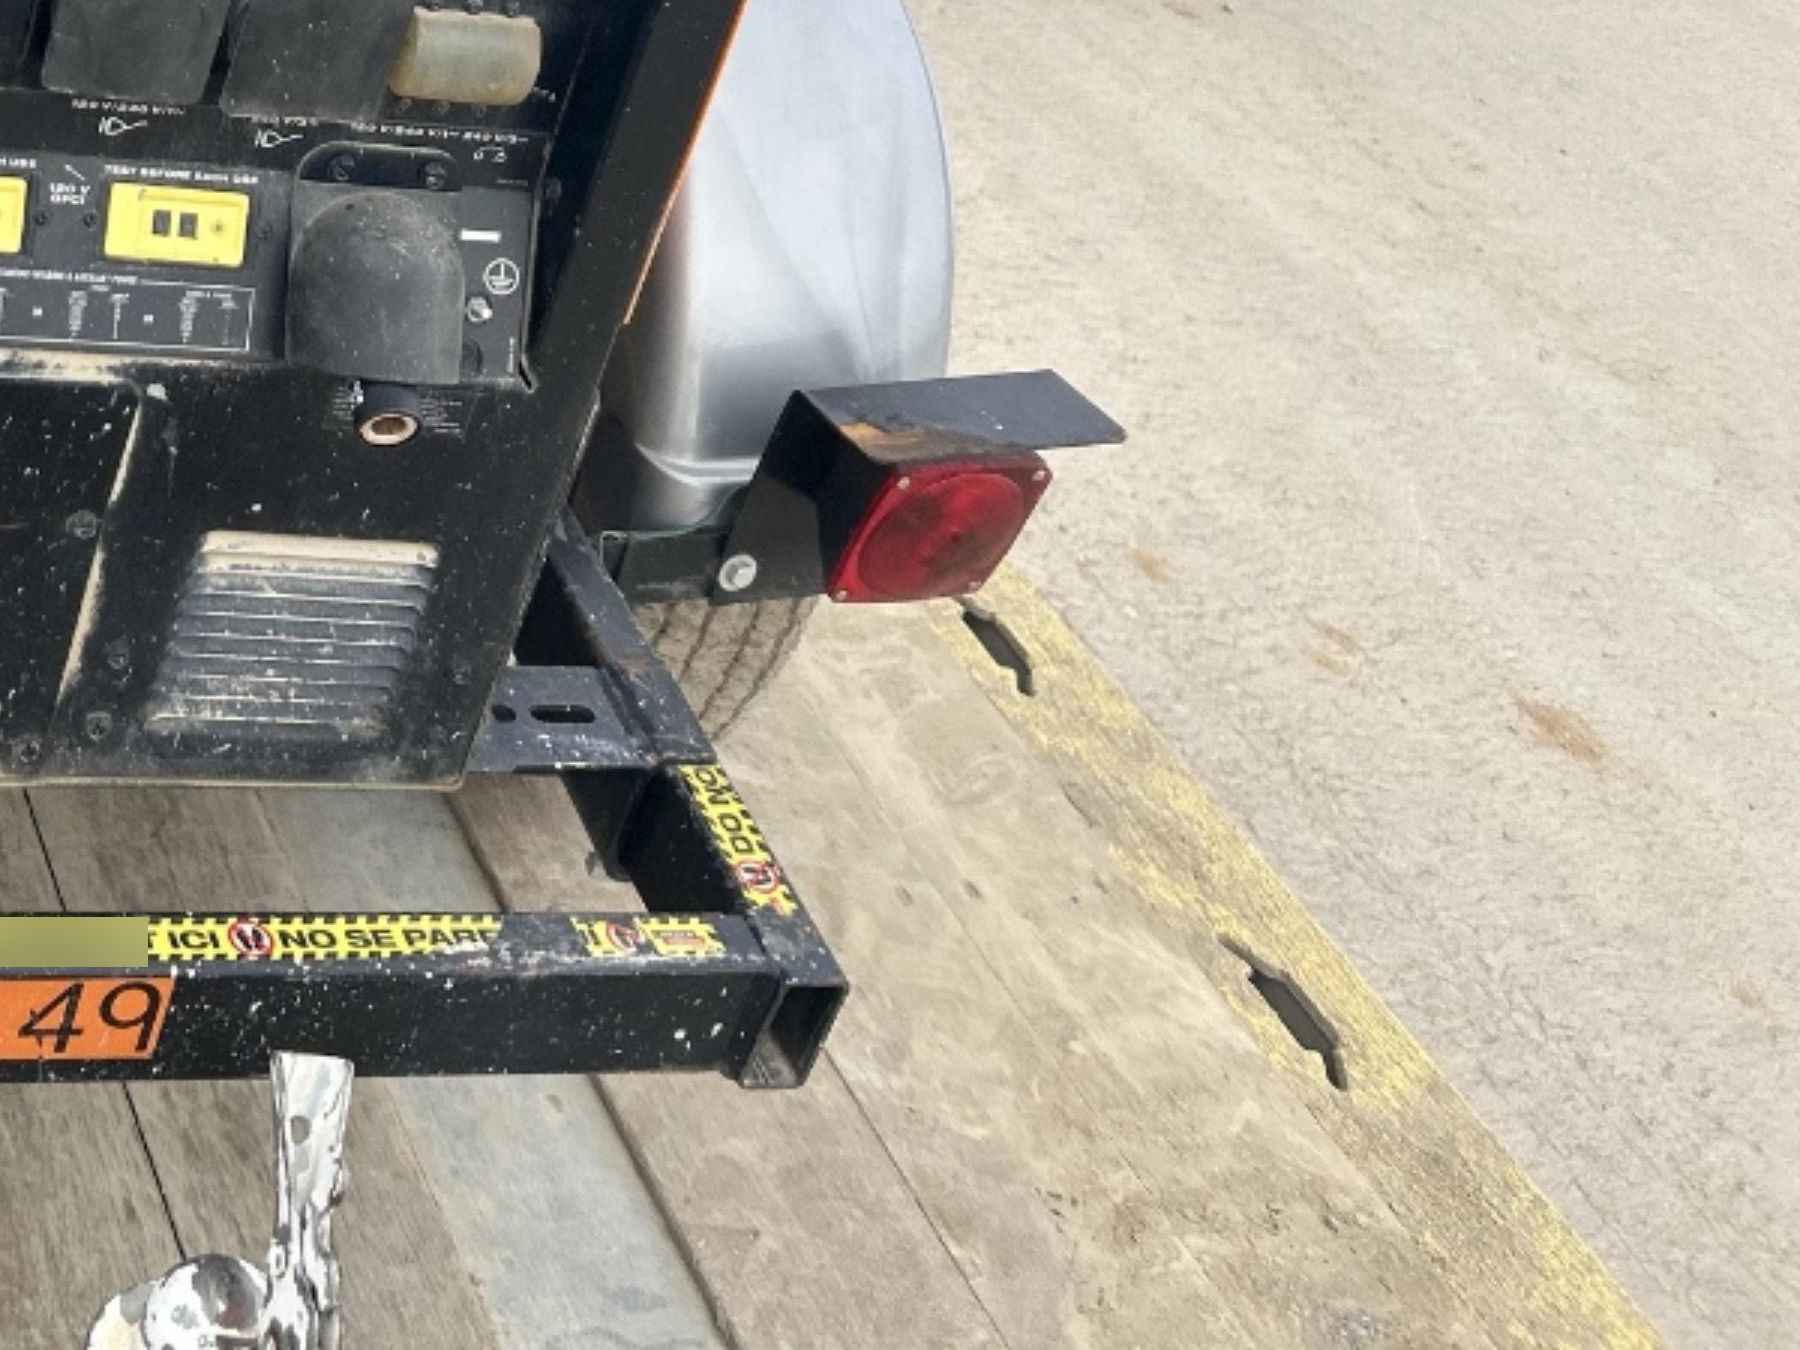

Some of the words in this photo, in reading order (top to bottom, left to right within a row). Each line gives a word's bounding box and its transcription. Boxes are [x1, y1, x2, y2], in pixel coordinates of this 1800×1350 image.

[9, 157, 37, 169] USE
[167, 930, 220, 949] ICI
[279, 929, 337, 949] NO
[346, 929, 396, 949] SE
